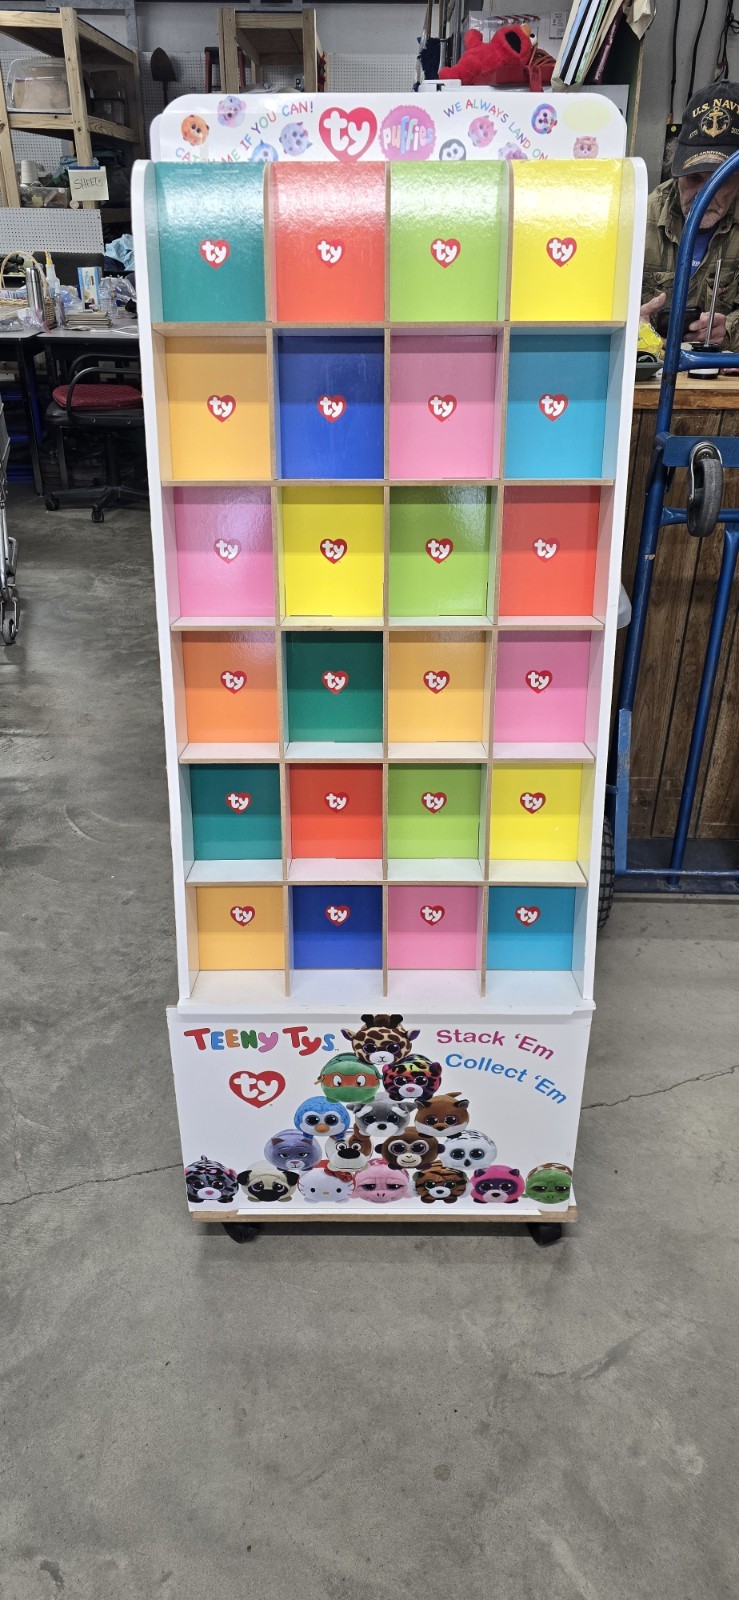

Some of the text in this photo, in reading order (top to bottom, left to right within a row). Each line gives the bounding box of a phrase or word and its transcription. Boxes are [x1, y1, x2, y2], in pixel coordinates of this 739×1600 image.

[240, 133, 253, 151] IF
[251, 111, 277, 134] YOU
[282, 101, 313, 117] CAN!
[323, 110, 371, 156] ty
[382, 115, 433, 154] puffies
[443, 101, 462, 118] WE
[465, 99, 509, 123] ALWAYS
[508, 121, 531, 149] LAND
[73, 176, 104, 190] SHEETS
[201, 240, 227, 264] ty
[317, 240, 343, 264] ty
[432, 239, 458, 264] ty
[548, 238, 574, 262] ty
[209, 396, 233, 418] ty
[319, 396, 344, 418] ty
[429, 396, 454, 418] ty
[540, 395, 565, 417] ty
[215, 539, 239, 560] ty
[321, 540, 345, 560] ty
[427, 539, 450, 560] ty
[534, 539, 557, 559] ty
[222, 672, 244, 690] ty
[324, 672, 346, 691] ty
[425, 672, 447, 690] ty
[527, 671, 550, 690] ty
[227, 793, 249, 811] ty
[326, 793, 347, 810] ty
[423, 793, 444, 810] ty
[521, 793, 543, 810] ty
[232, 907, 253, 923] ty
[327, 906, 348, 923] ty
[421, 906, 442, 923] ty
[517, 907, 538, 923] ty
[183, 1027, 279, 1053] TEENY
[436, 1029, 506, 1046] Stack
[445, 1053, 528, 1083] Collect
[233, 1072, 280, 1102] ty
